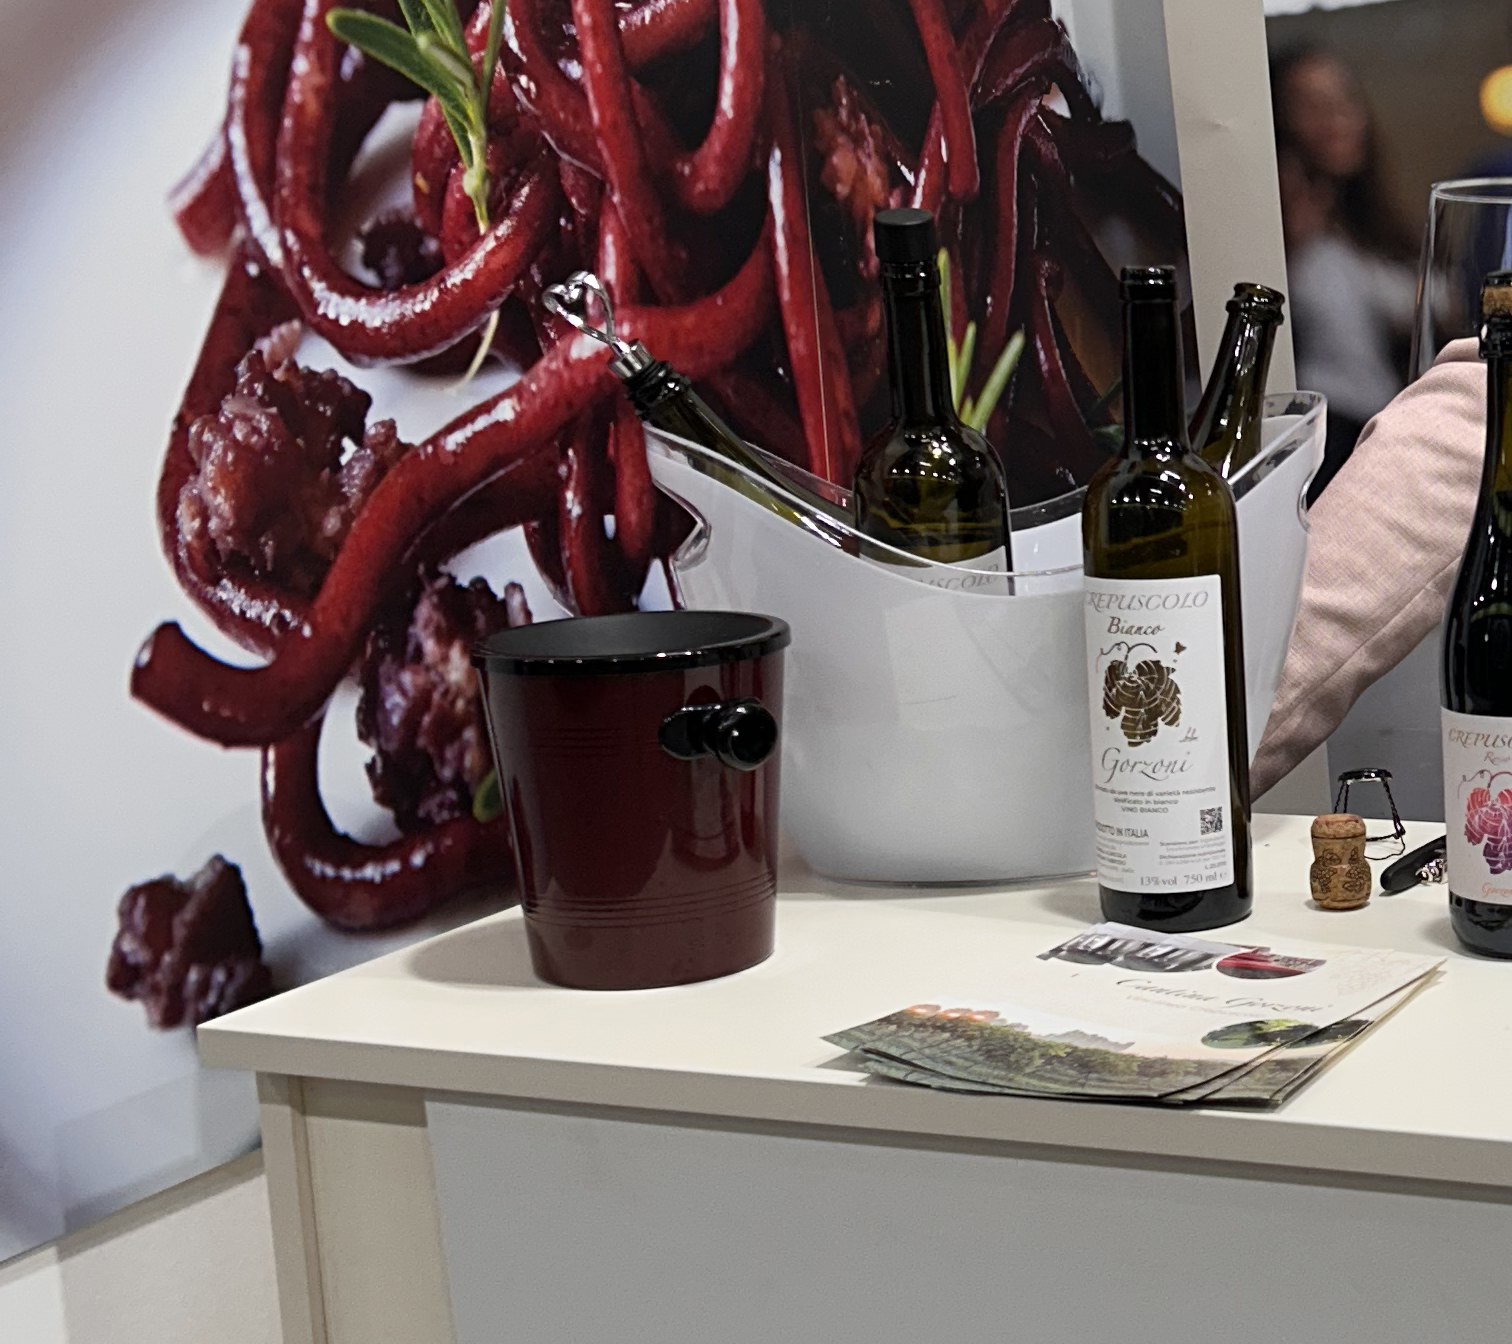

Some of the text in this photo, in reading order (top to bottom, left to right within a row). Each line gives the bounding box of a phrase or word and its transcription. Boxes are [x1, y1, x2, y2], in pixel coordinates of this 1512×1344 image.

[1107, 615, 1166, 636] Bianco
[1101, 746, 1193, 784] Gorzoni
[1124, 827, 1149, 838] ITALIA
